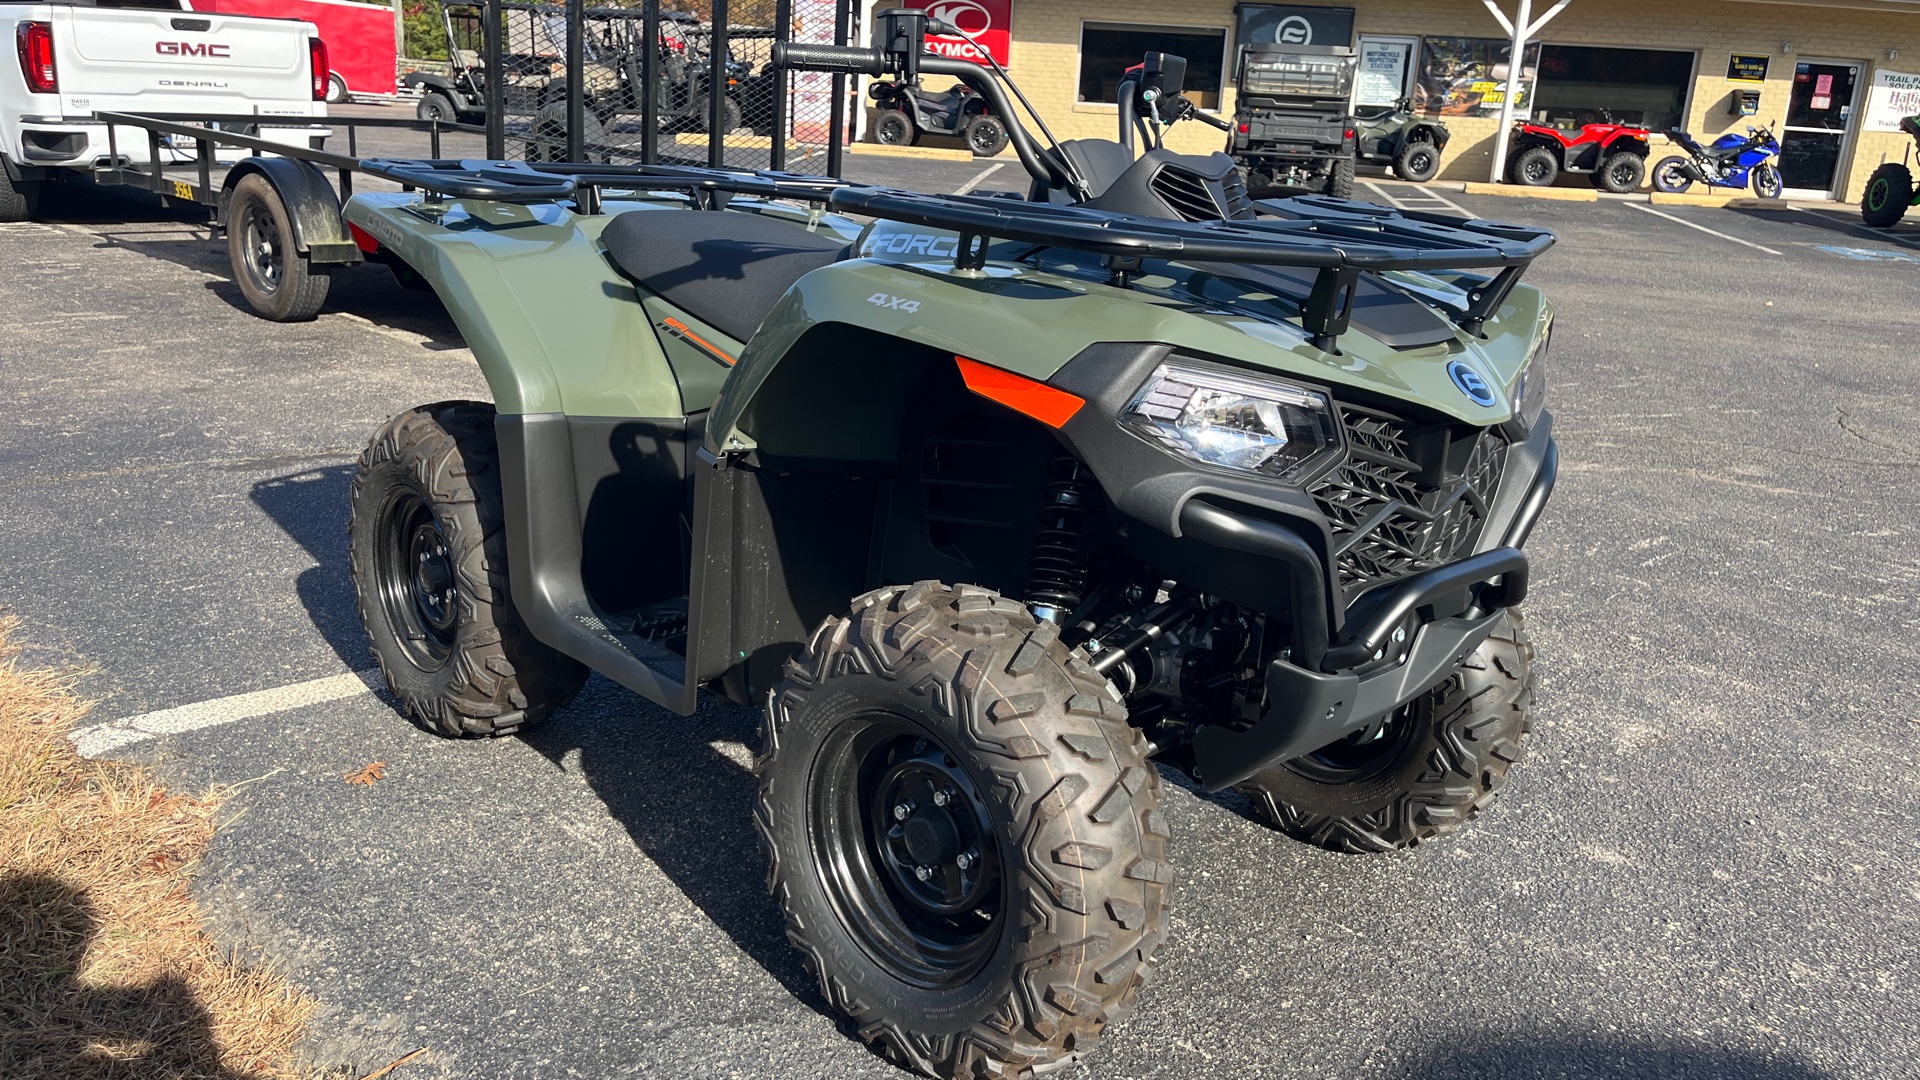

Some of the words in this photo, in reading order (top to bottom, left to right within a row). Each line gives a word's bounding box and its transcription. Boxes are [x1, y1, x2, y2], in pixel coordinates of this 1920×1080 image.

[155, 41, 231, 58] GMC
[158, 80, 228, 88] DENALI
[1884, 74, 1910, 83] TRAIL
[1889, 82, 1913, 90] SOLD
[366, 213, 404, 247] CFMOTO
[799, 891, 866, 985] CFMOTO
